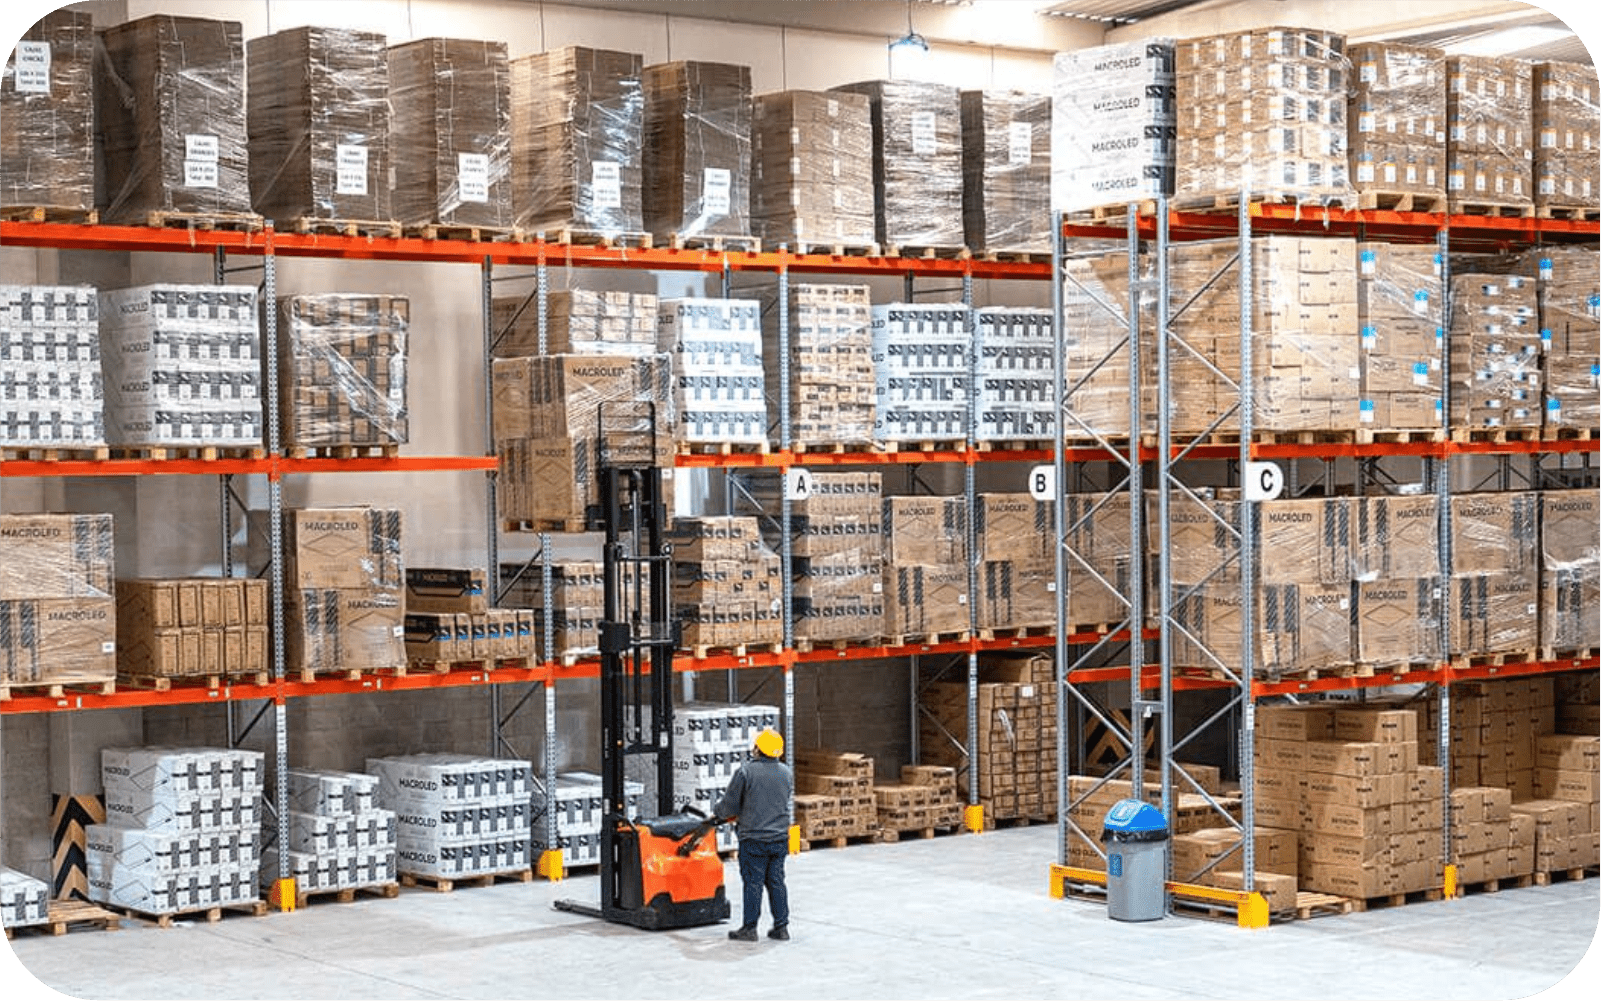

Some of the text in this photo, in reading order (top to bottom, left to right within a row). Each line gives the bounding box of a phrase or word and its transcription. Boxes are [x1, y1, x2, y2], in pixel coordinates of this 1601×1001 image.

[797, 475, 806, 493] A
[1036, 474, 1046, 492] B
[1261, 469, 1273, 492] C
